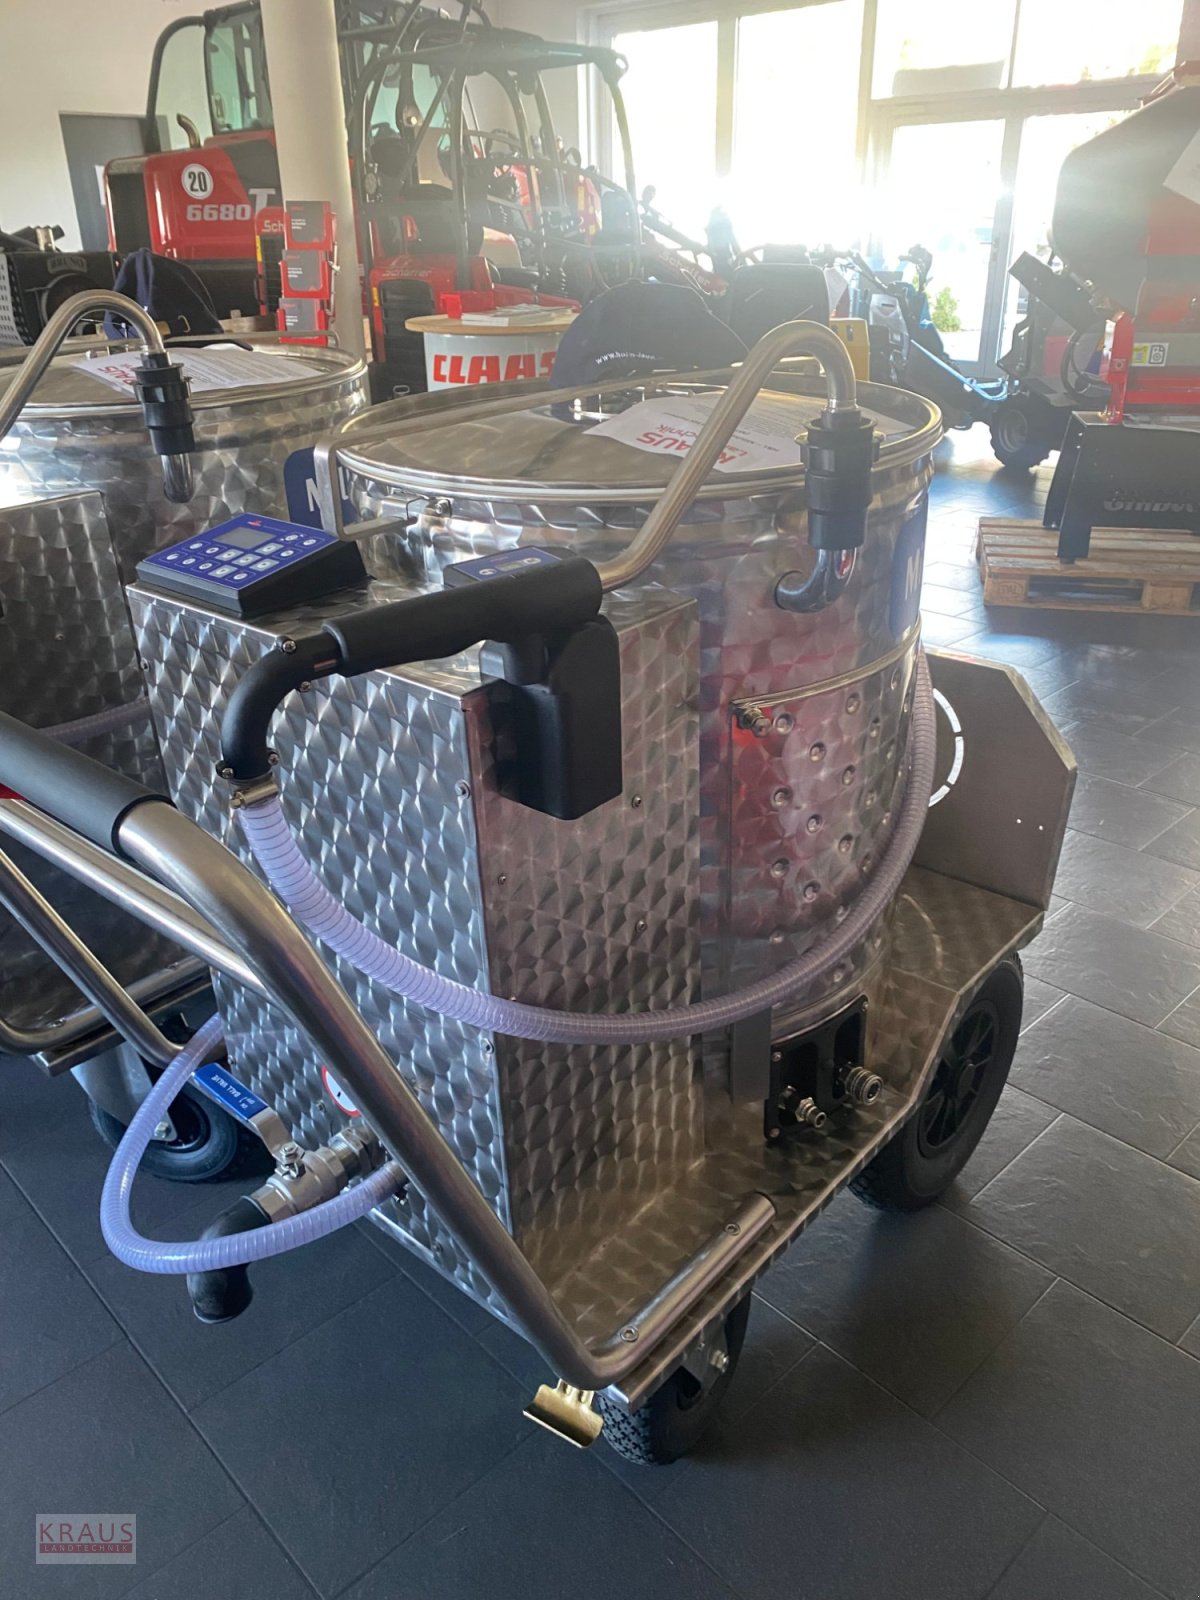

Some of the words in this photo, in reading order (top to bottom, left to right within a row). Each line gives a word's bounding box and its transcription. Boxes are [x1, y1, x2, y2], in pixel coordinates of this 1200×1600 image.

[188, 171, 208, 193] 20
[186, 204, 252, 221] 6680
[248, 188, 276, 215] T
